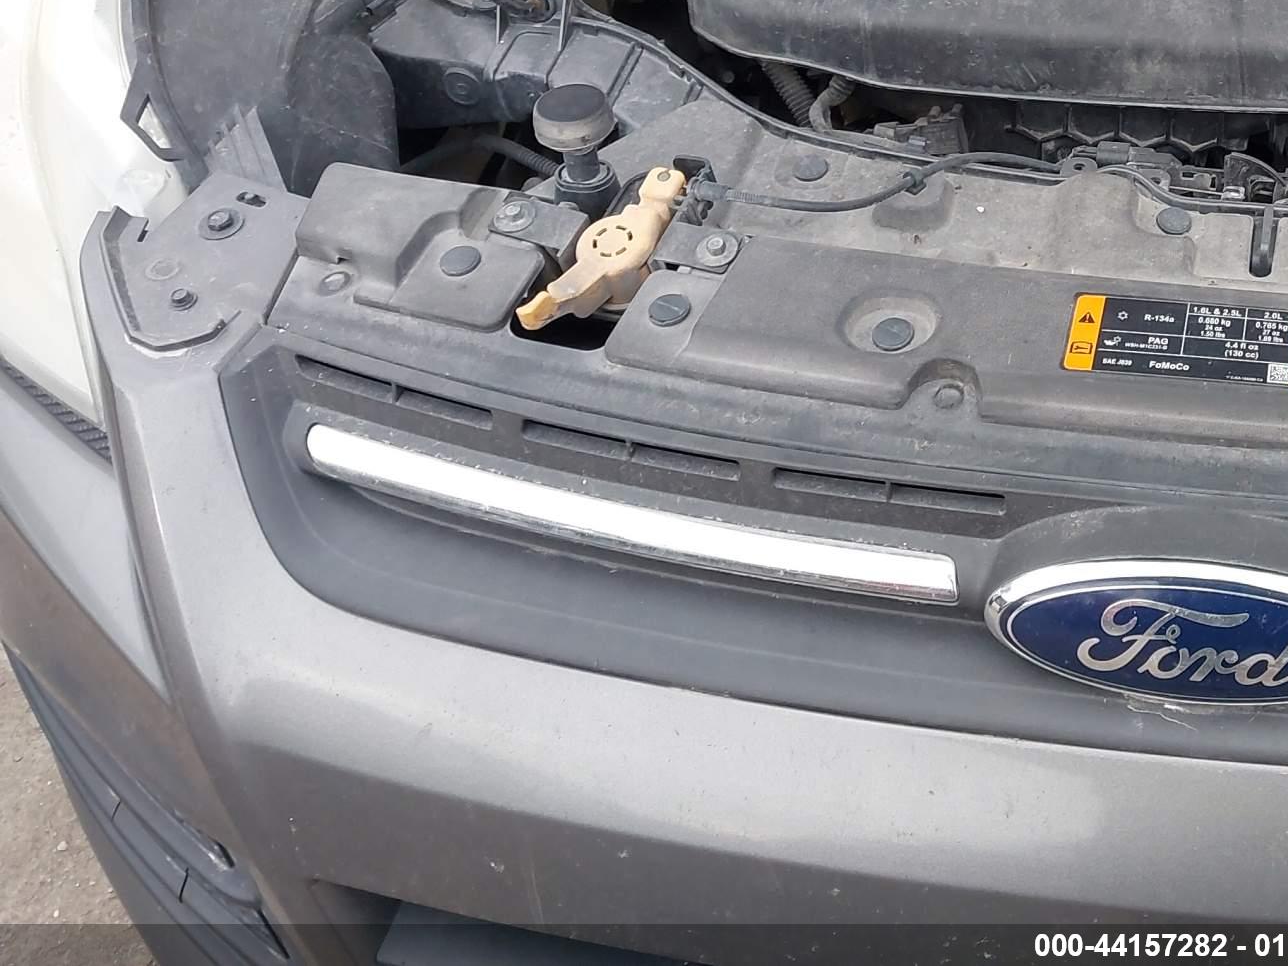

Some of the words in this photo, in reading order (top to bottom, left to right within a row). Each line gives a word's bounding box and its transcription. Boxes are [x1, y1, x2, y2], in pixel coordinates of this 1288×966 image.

[1193, 306, 1211, 315] 1.6L
[1223, 308, 1242, 317] 2.5L
[1264, 312, 1283, 320] 2.0L
[1144, 313, 1175, 323] R-134a
[1221, 318, 1231, 327] kg
[1278, 323, 1288, 332] kg
[1147, 336, 1169, 345] PAG
[1224, 341, 1239, 349] 4.4
[1224, 349, 1243, 358] (130
[1245, 350, 1259, 360] cc)
[1149, 360, 1190, 371] FoMoCo
